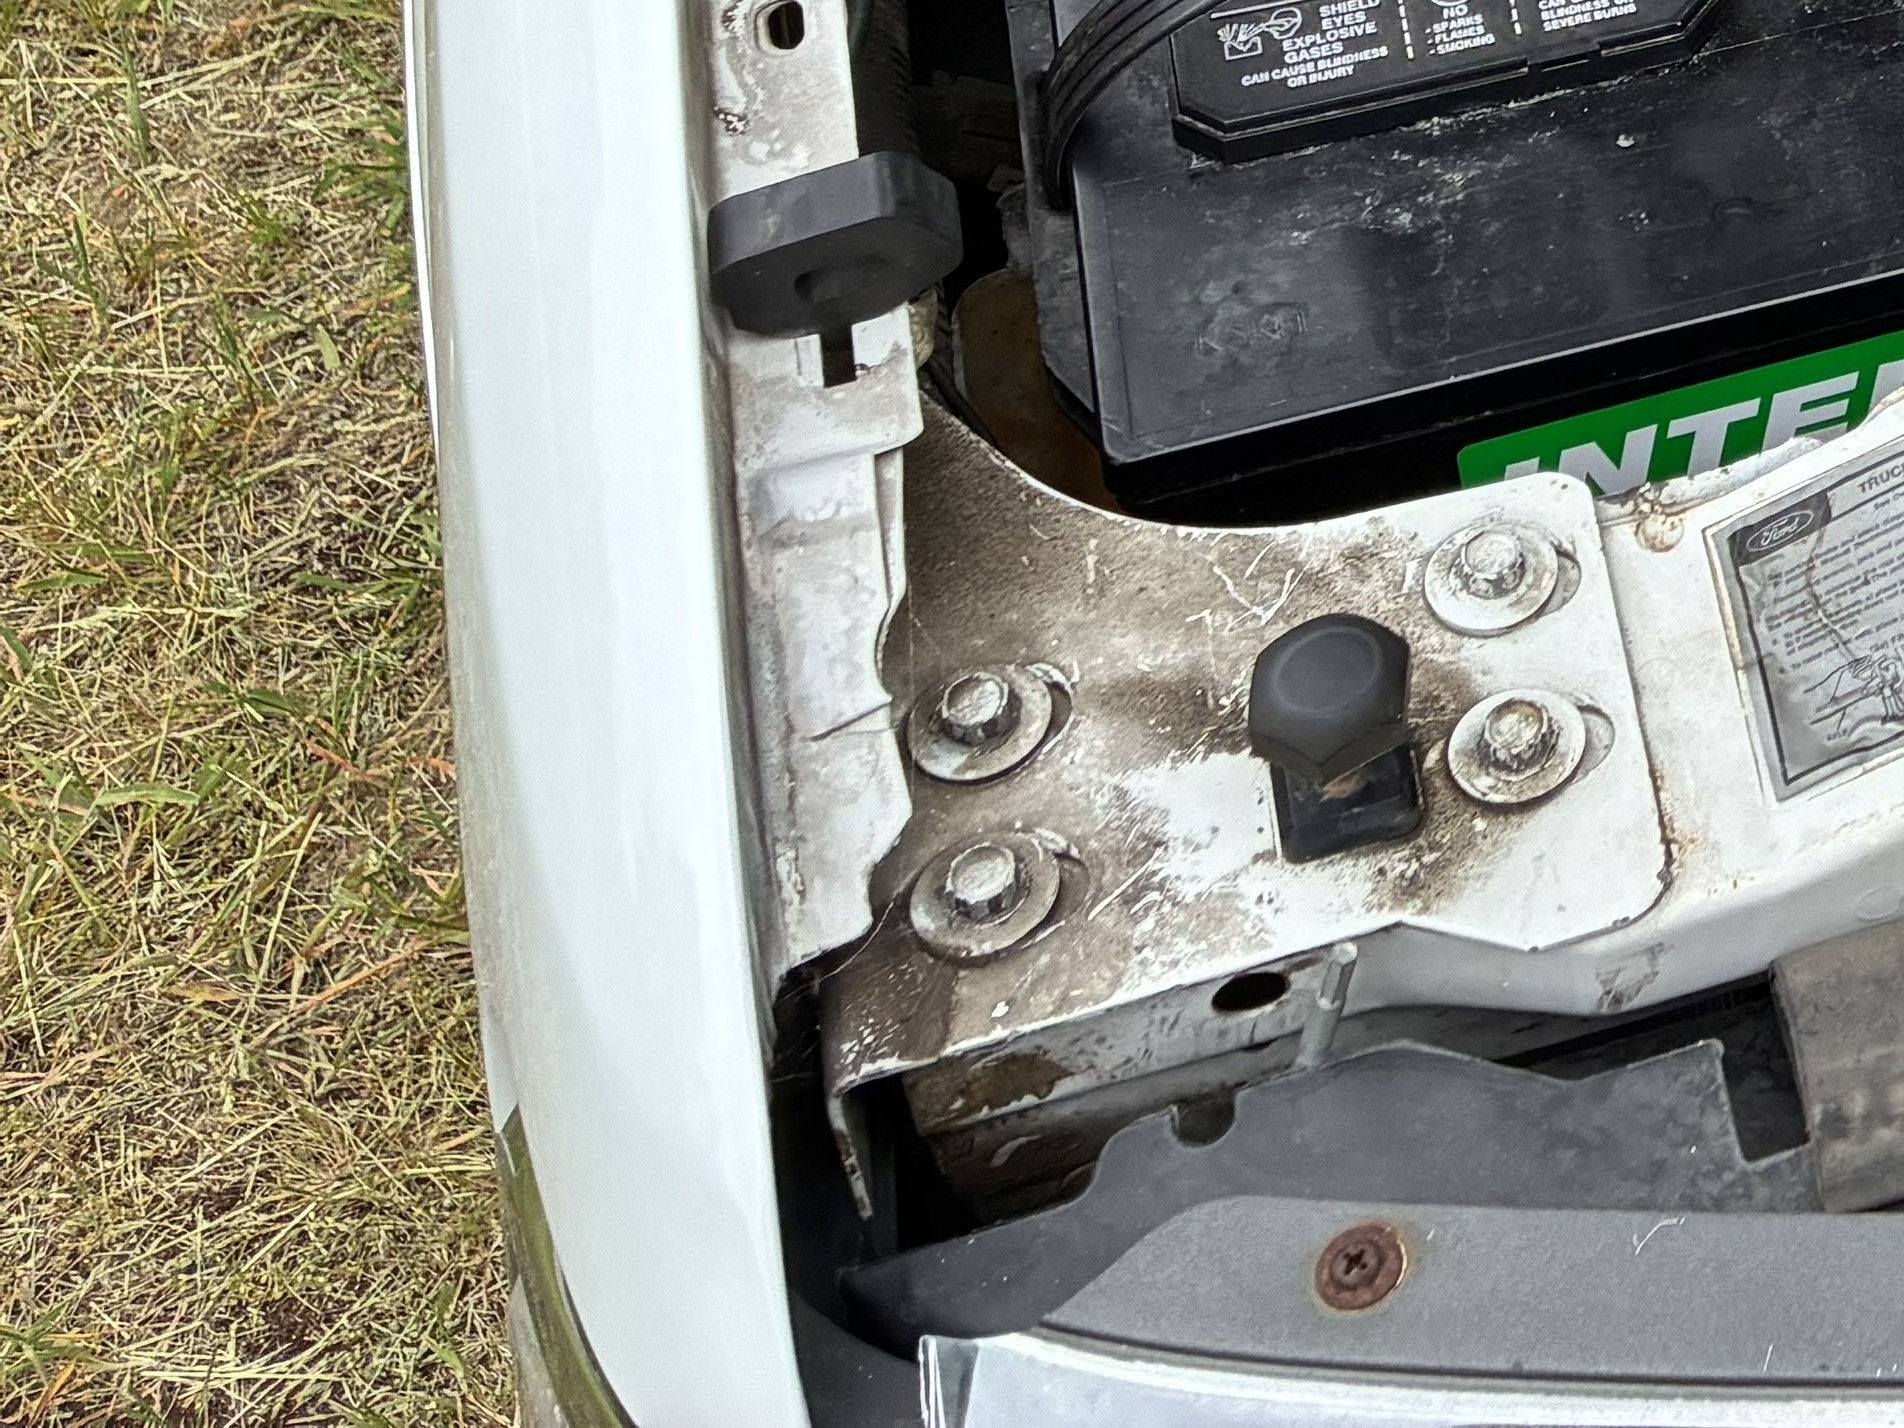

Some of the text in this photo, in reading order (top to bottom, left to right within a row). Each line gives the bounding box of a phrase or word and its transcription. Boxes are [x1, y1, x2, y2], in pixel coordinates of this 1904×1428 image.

[1319, 9, 1368, 31] EYES
[1442, 4, 1469, 20] NO
[1280, 20, 1378, 52] EXPLOSIVE
[1282, 40, 1344, 64] GASES
[1270, 60, 1315, 80] CAUSE
[1758, 510, 1808, 548] Ford
